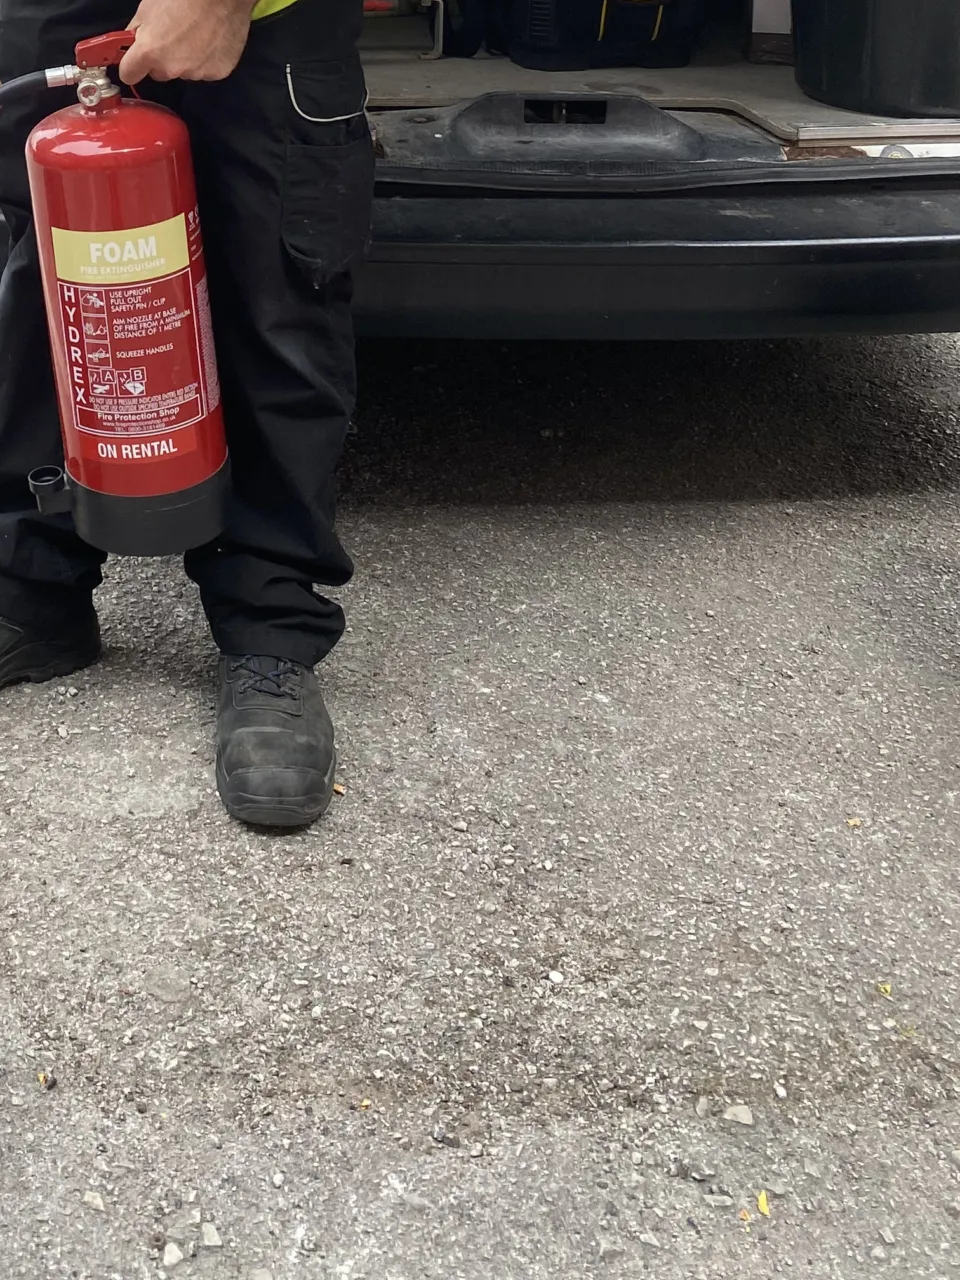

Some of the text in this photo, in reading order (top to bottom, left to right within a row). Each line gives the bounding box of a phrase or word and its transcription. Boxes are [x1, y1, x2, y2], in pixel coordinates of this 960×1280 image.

[89, 236, 157, 263] FOAM
[80, 257, 166, 275] FIRE EXTINGUISHER
[124, 287, 152, 297] UPRIGHT
[127, 296, 142, 304] OUT
[111, 303, 134, 312] SAFETY
[136, 302, 147, 310] PIN
[153, 297, 166, 307] CLIP
[124, 323, 138, 331] FIRE
[139, 320, 159, 330] FROM
[165, 309, 191, 323] MINIMUM
[126, 315, 153, 324] NOZZLE
[153, 312, 162, 320] AT
[162, 307, 176, 317] BASE
[114, 329, 149, 339] DISTANCE
[163, 320, 181, 332] METRE
[116, 342, 174, 359] SQUEEZE HANDLES
[104, 371, 113, 381] A
[133, 370, 143, 380] B
[98, 406, 180, 421] Fire Protection Shop
[97, 438, 178, 459] ON RENTAL
